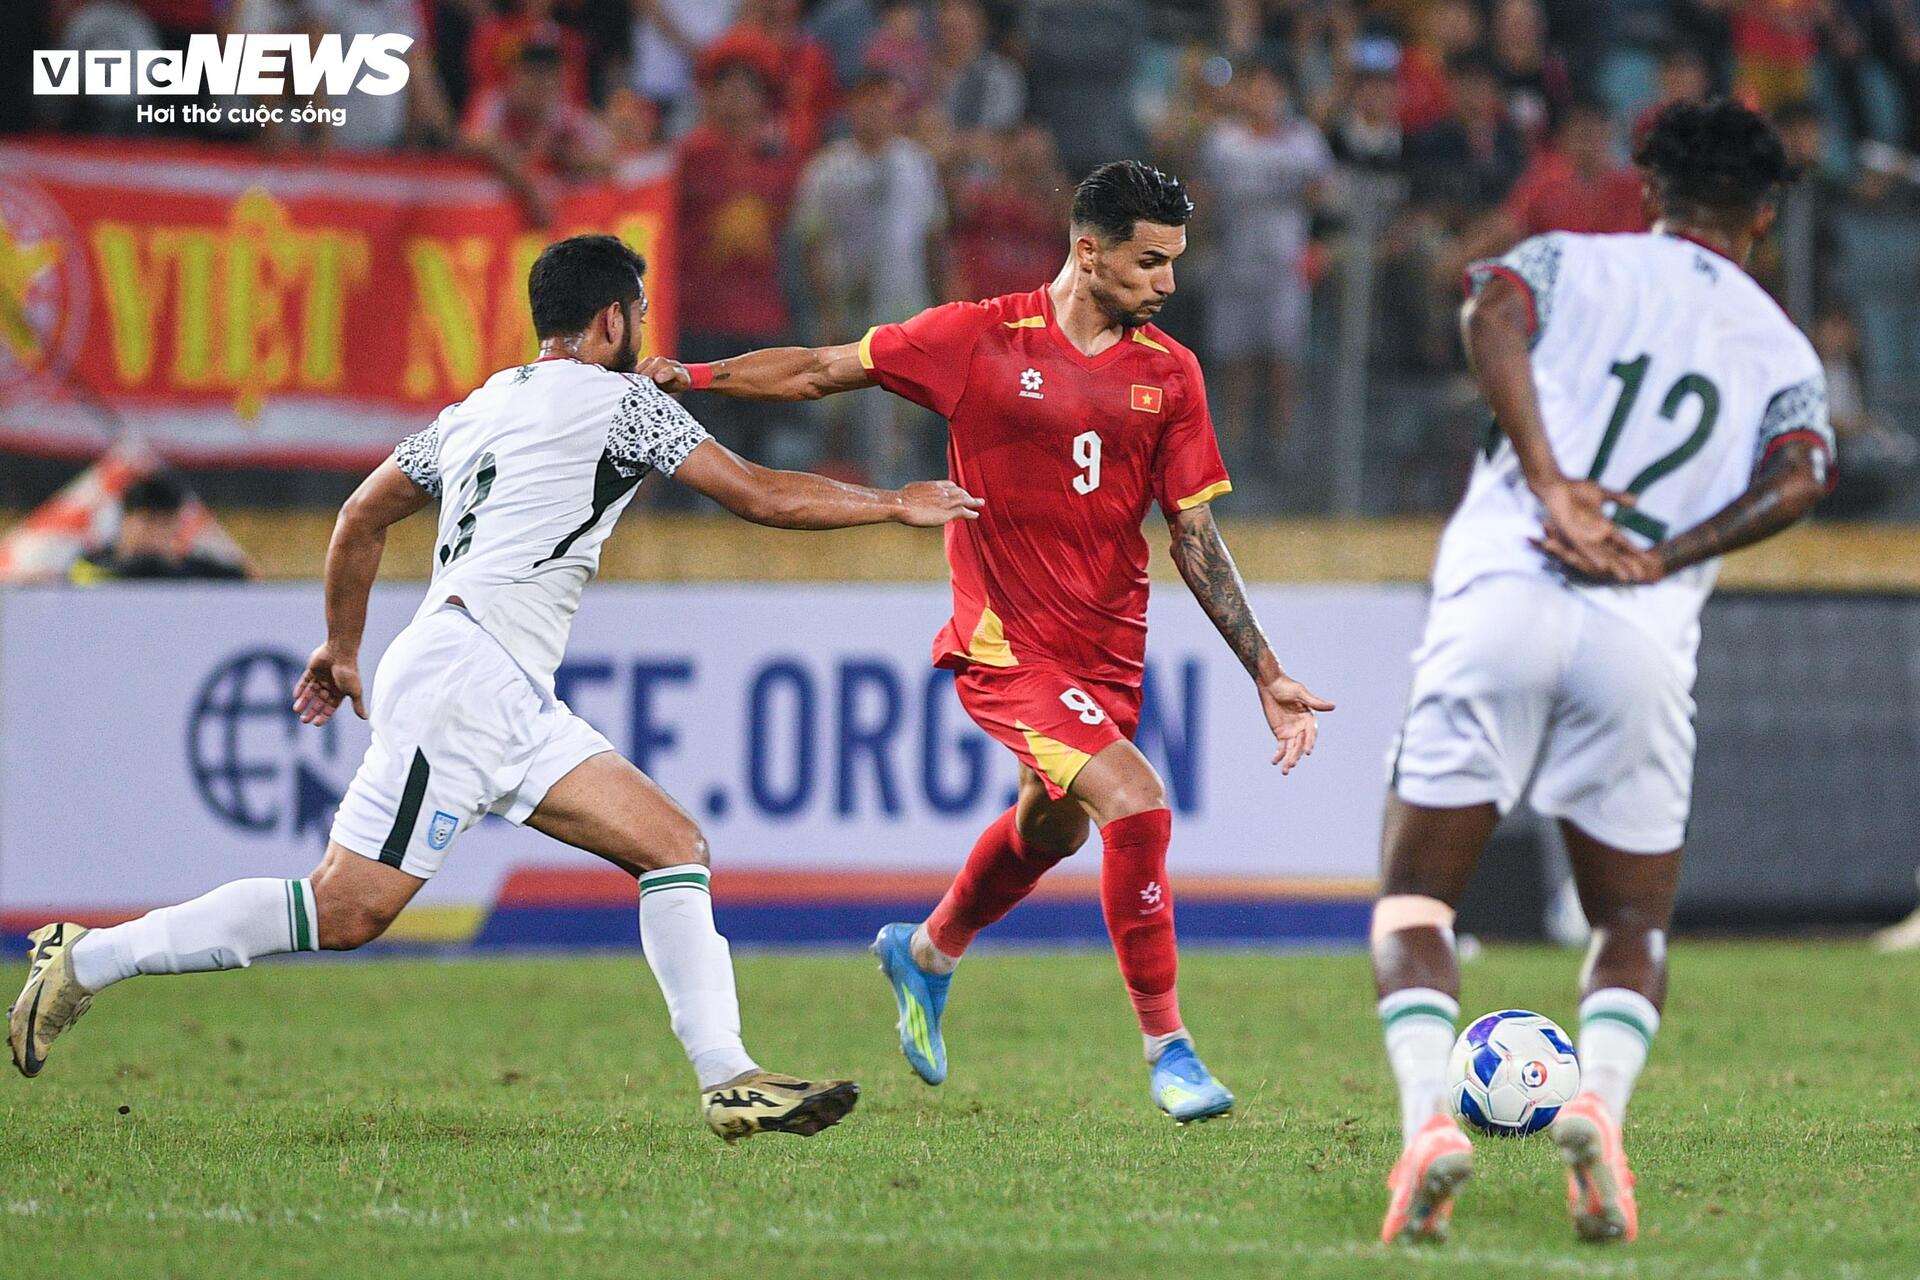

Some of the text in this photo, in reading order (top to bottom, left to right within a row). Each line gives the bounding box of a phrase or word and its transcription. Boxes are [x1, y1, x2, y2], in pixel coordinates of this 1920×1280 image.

[95, 187, 370, 422] VIỆT
[1072, 430, 1103, 496] 9
[1588, 353, 1720, 542] 12
